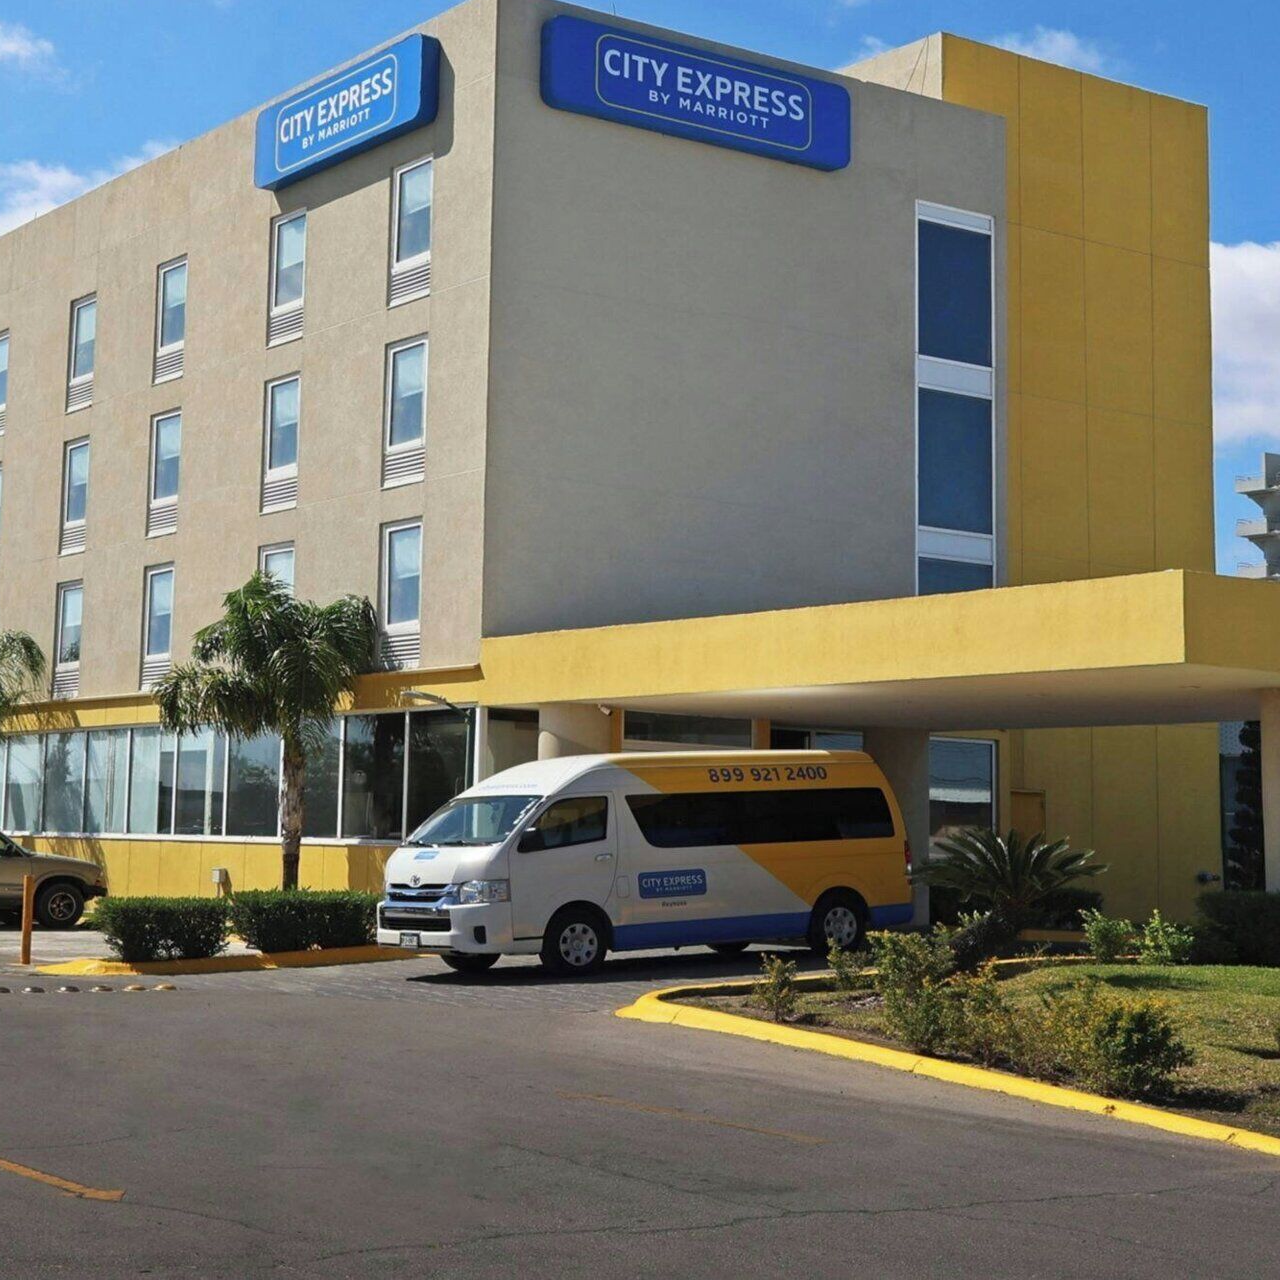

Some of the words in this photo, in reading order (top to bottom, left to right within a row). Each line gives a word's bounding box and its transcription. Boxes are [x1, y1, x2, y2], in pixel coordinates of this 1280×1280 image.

[280, 106, 315, 143] CITY
[317, 67, 393, 127] EXPRESS
[604, 48, 669, 87] CITY
[676, 65, 805, 121] EXPRESS
[302, 134, 315, 150] BY
[318, 107, 370, 141] MARRIOTT
[648, 89, 671, 105] BY
[678, 97, 770, 129] MARRIOTT
[708, 768, 744, 783] 899
[750, 768, 780, 782] 921
[784, 766, 827, 781] 2400
[642, 877, 661, 888] CITY
[663, 874, 703, 886] EXPRESS
